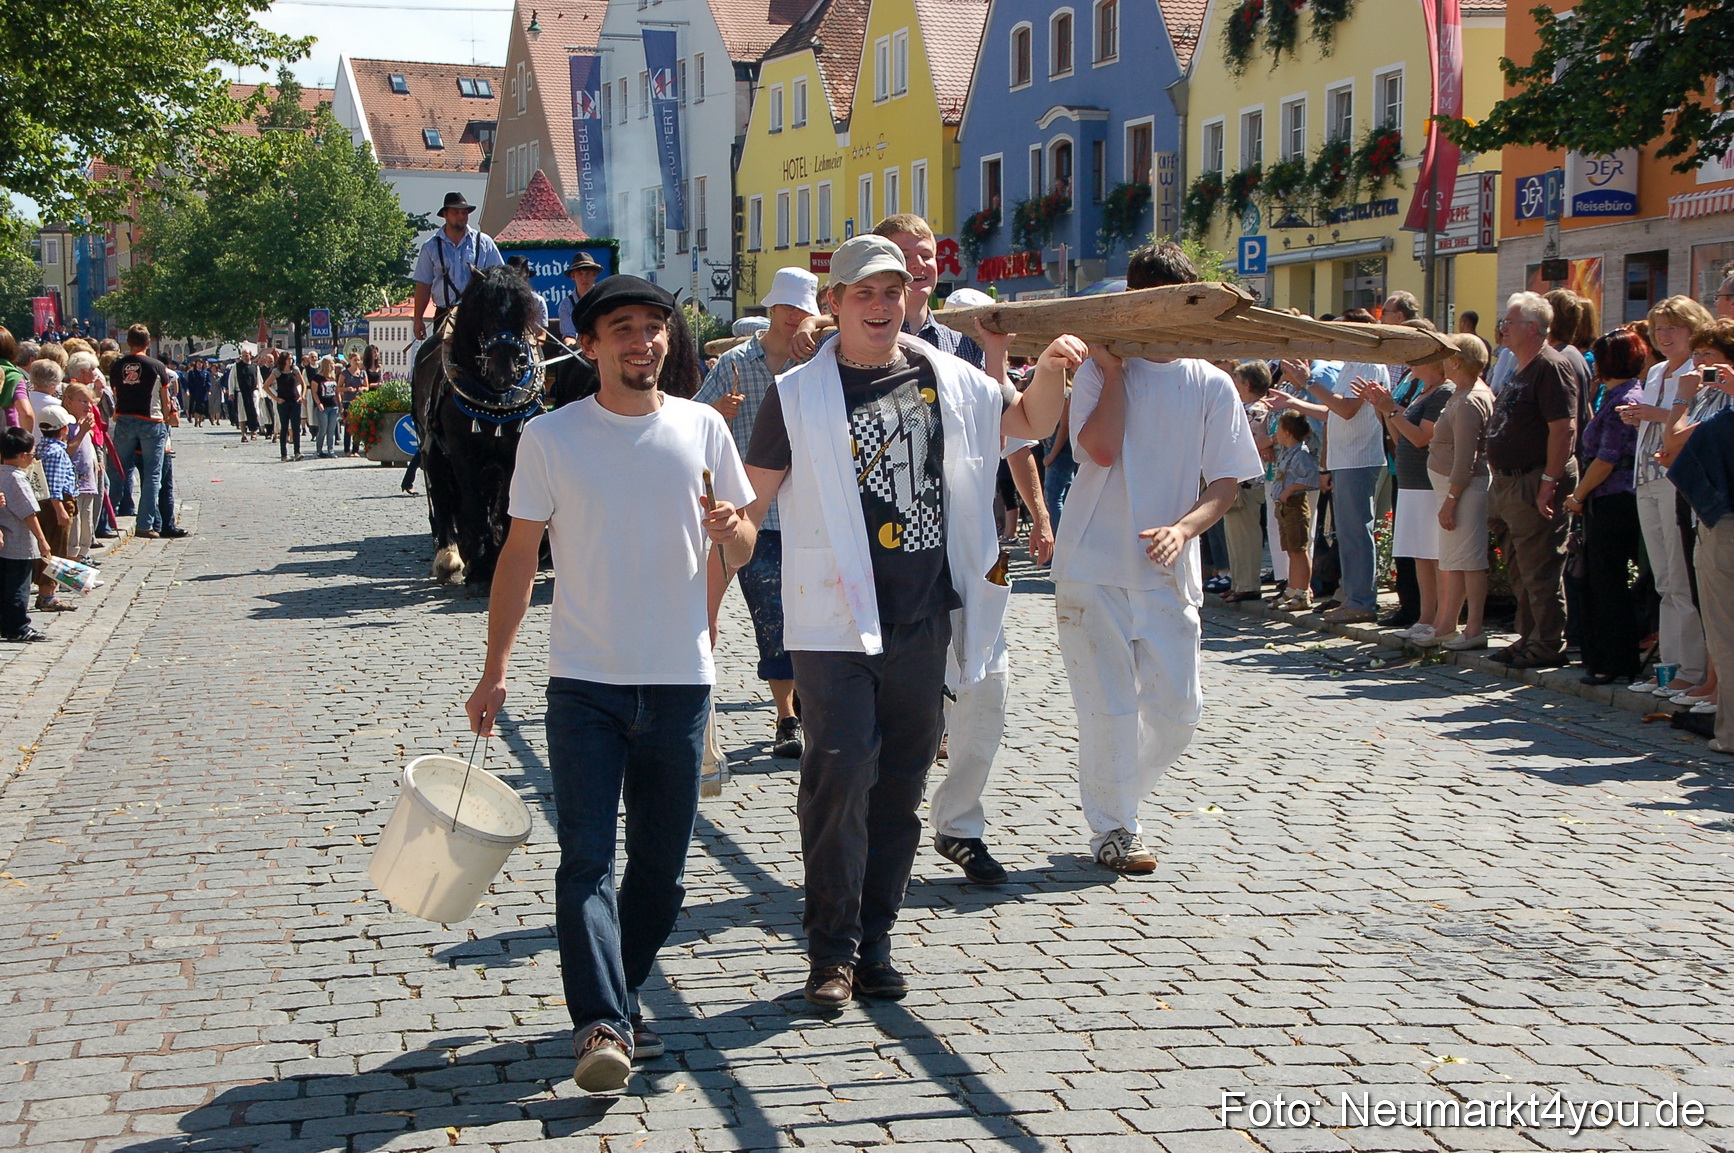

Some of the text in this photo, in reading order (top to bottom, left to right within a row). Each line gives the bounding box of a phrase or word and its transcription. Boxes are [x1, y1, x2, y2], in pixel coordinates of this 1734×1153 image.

[783, 156, 808, 181] HOTEL
[1159, 153, 1175, 169] CAFÉ
[1585, 160, 1624, 184] DER
[1160, 172, 1174, 232] WITT
[1482, 175, 1492, 246] KINO
[1521, 187, 1543, 214] DER
[1575, 200, 1632, 211] Reisebüro
[1244, 240, 1261, 271] P
